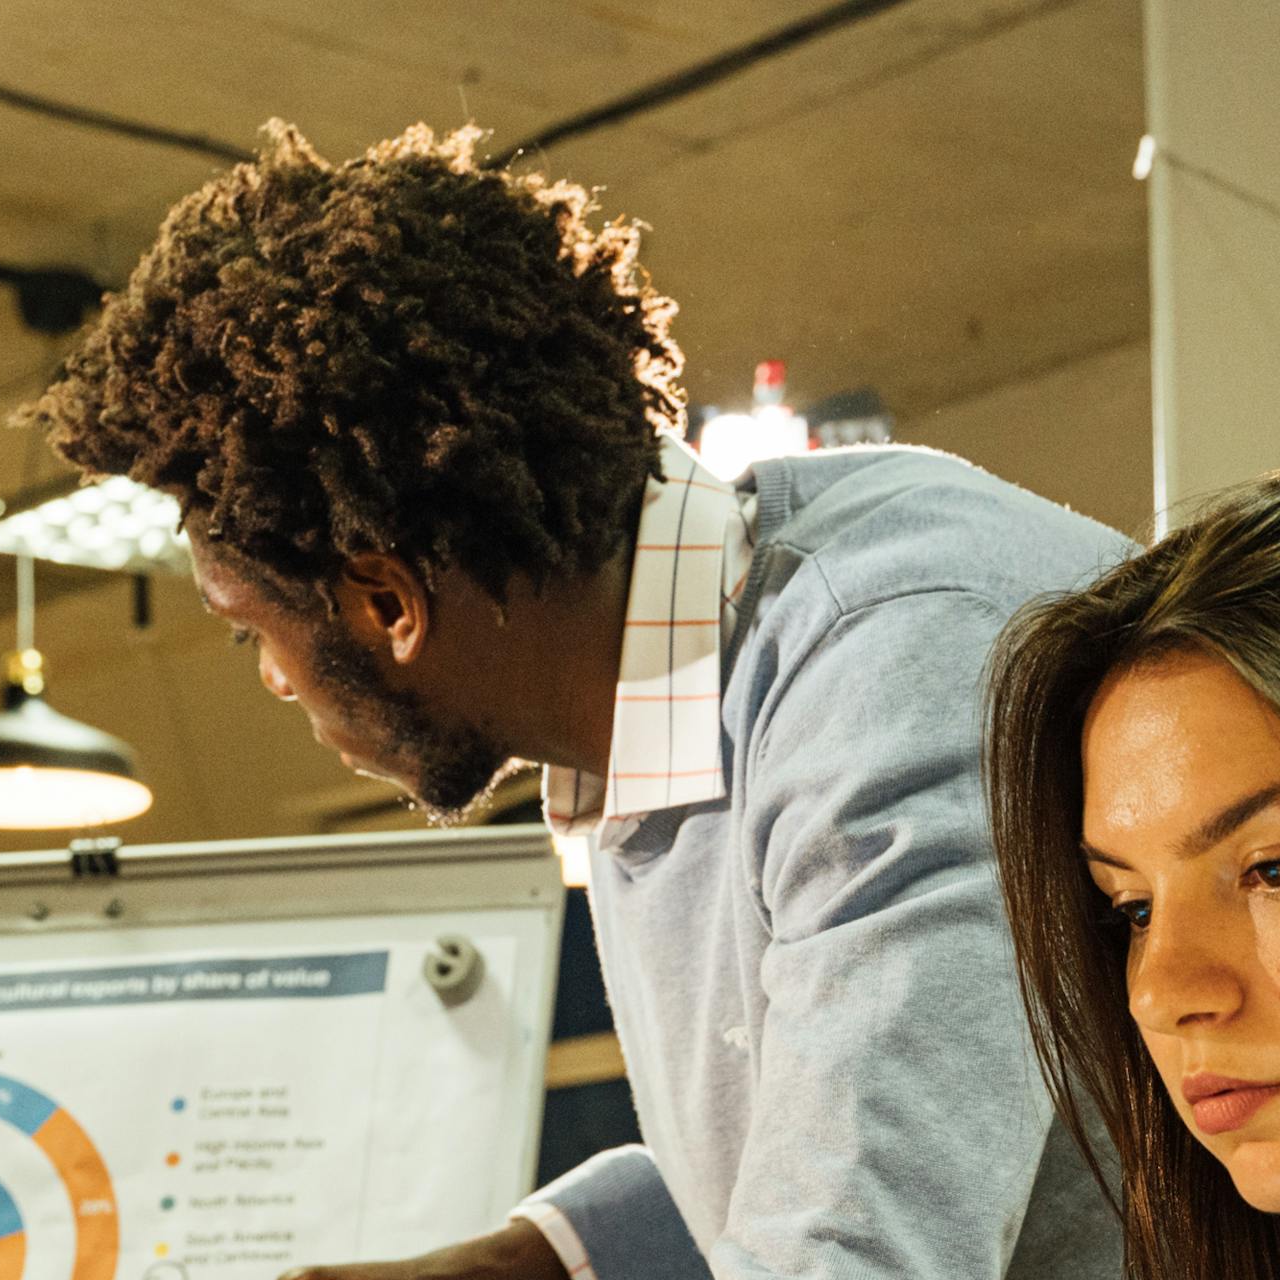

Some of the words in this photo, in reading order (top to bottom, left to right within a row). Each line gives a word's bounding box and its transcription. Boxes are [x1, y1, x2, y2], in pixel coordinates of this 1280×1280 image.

[70, 976, 148, 999] exports
[151, 973, 179, 996] by
[182, 967, 242, 991] share
[245, 967, 271, 989] of
[272, 965, 332, 989] value
